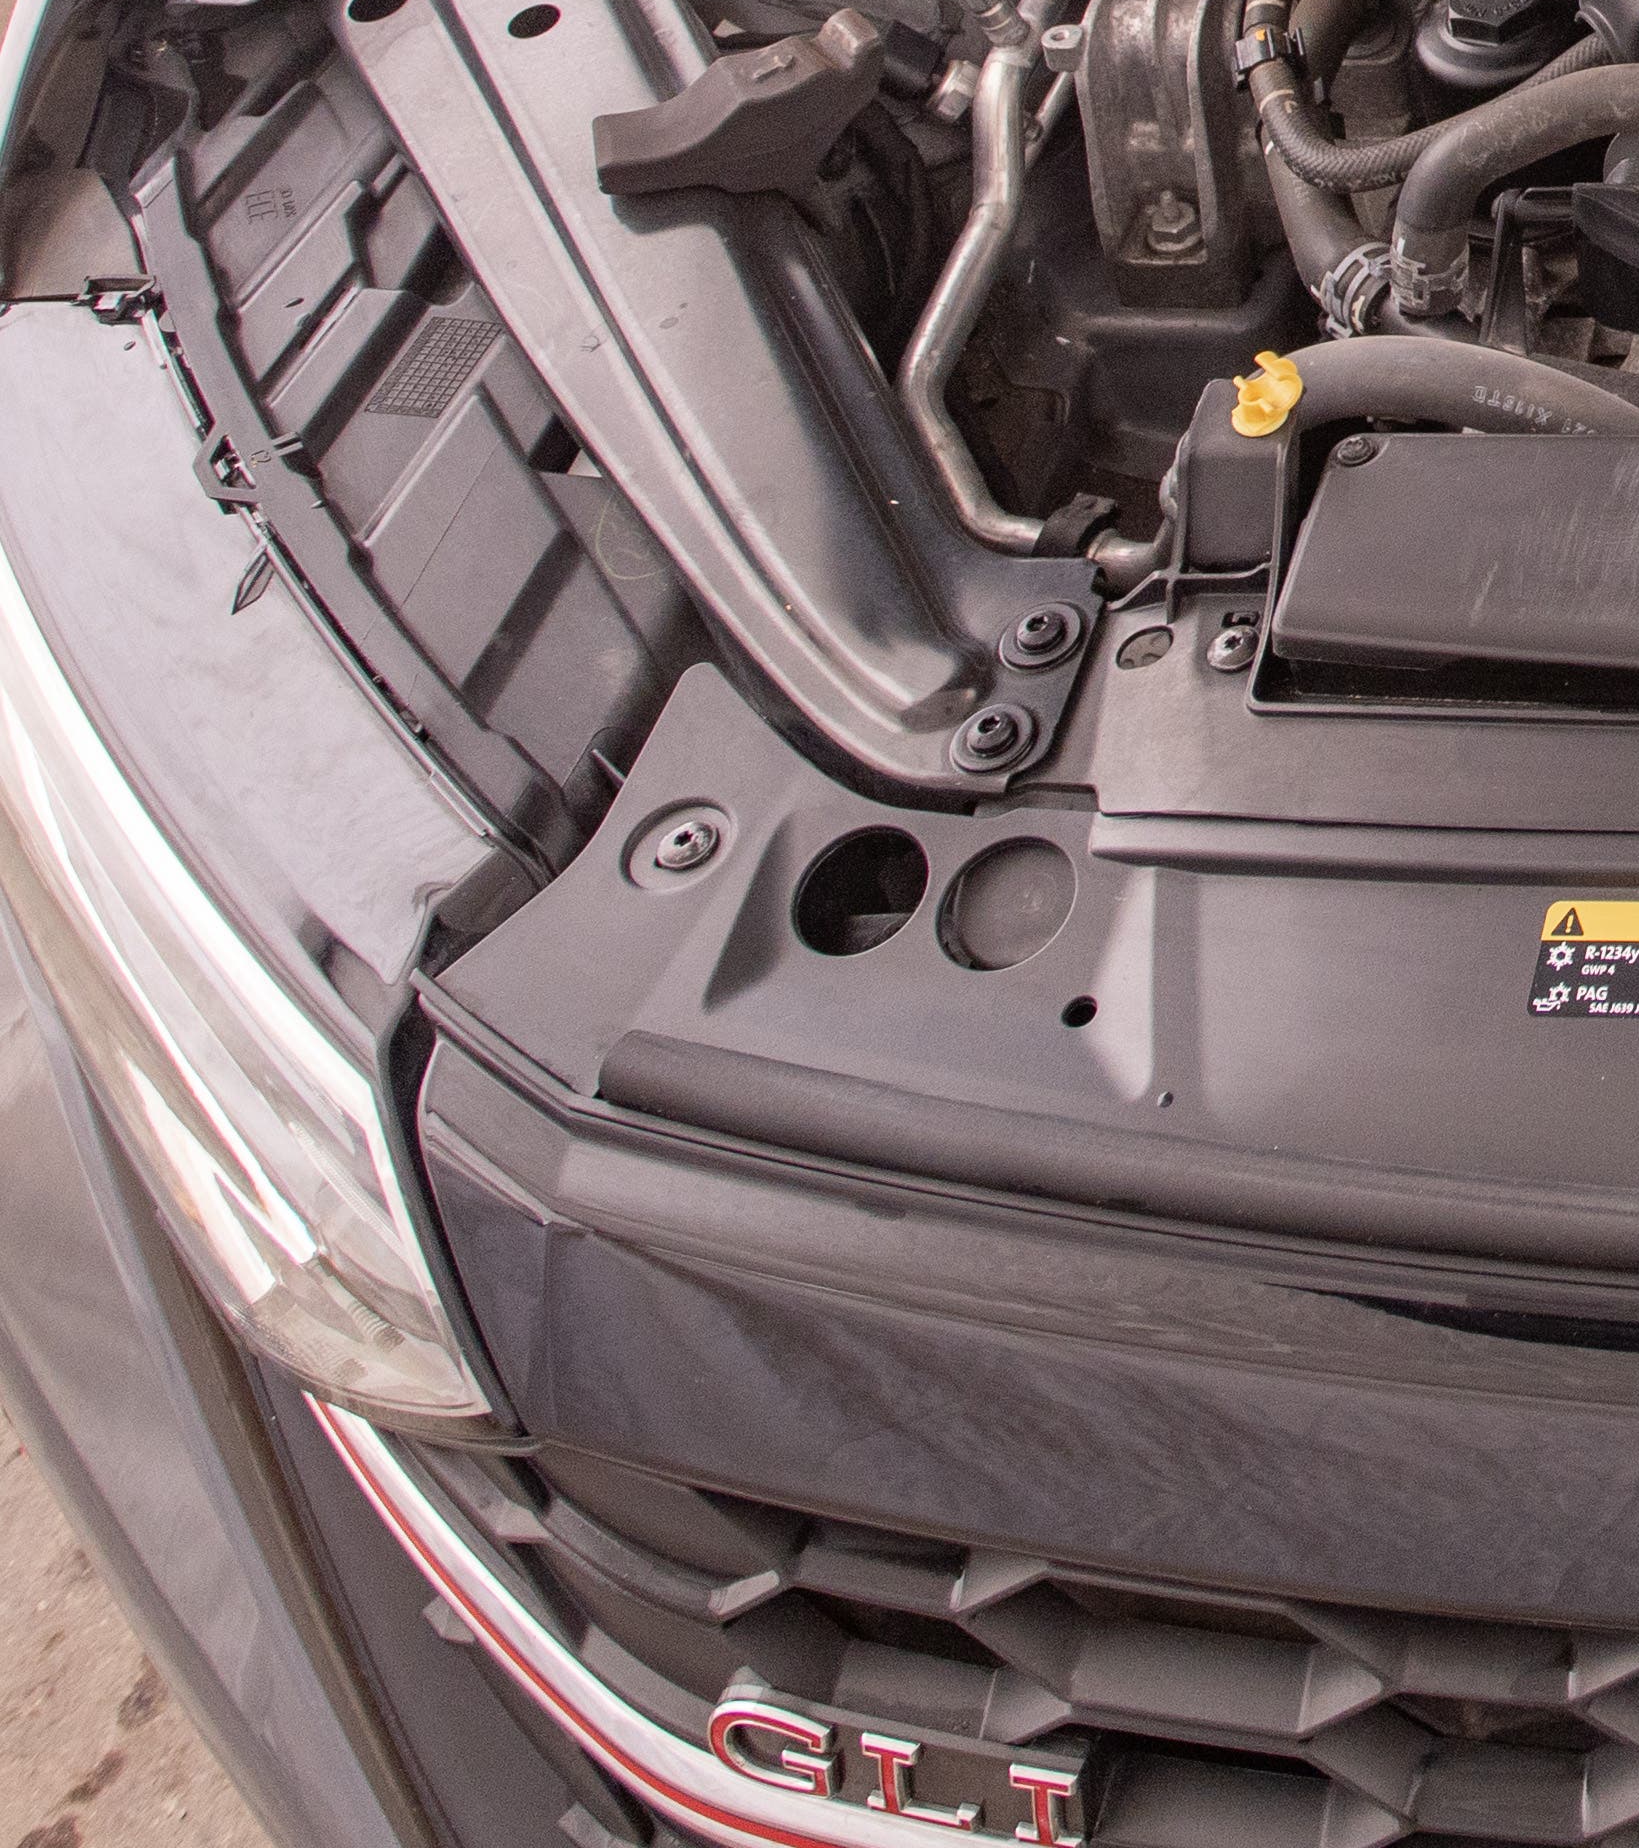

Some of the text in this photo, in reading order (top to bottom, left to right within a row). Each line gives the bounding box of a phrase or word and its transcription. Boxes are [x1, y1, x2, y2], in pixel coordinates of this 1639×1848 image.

[1581, 964, 1607, 976] GWP
[1607, 965, 1616, 975] 4
[1576, 986, 1609, 1001] PAG
[1589, 1002, 1610, 1014] SAE
[1610, 1002, 1634, 1015] J639
[708, 1699, 1083, 1848] GLI
